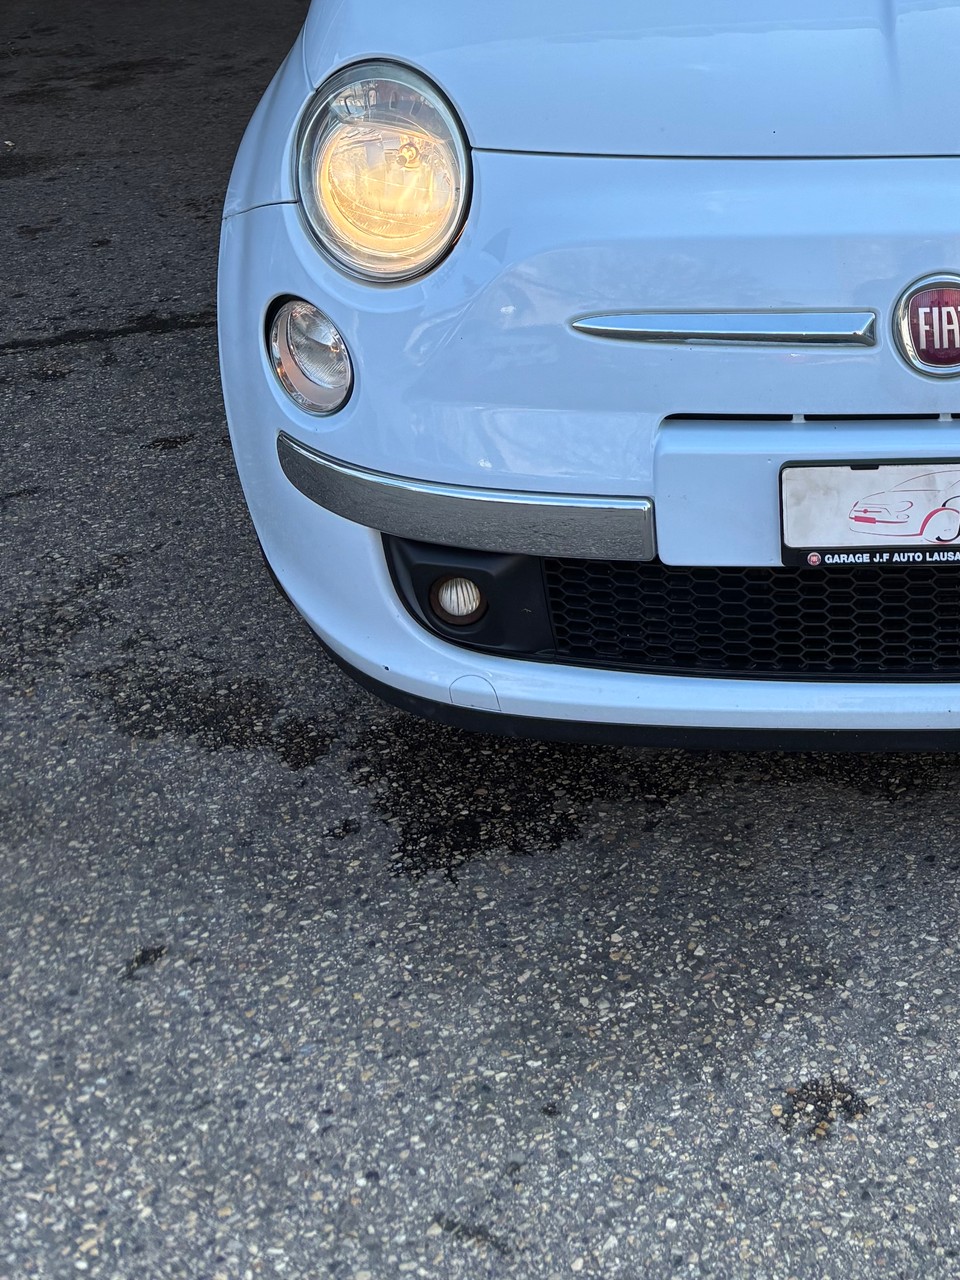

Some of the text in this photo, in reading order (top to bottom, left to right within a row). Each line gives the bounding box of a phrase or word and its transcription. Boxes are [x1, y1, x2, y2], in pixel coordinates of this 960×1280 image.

[824, 553, 871, 563] GARAGE
[873, 552, 890, 563] J.F
[892, 552, 923, 562] AUTO
